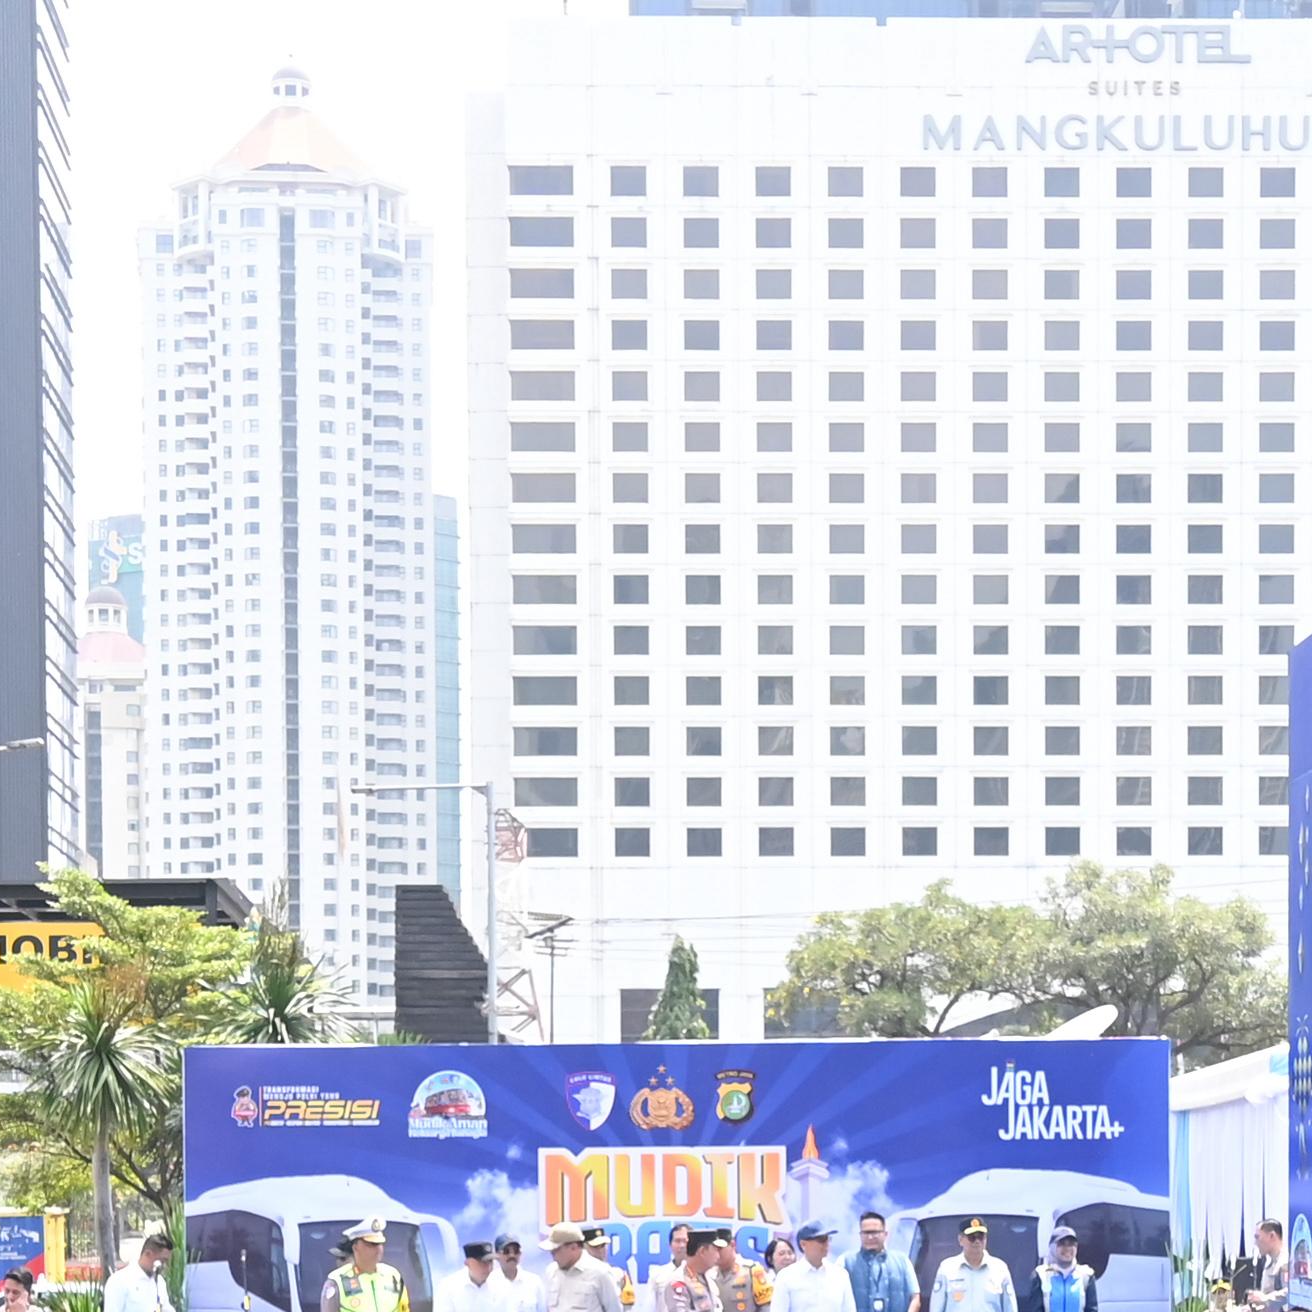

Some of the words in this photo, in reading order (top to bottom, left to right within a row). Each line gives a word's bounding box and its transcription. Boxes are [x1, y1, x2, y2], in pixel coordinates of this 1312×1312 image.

[1088, 80, 1182, 97] SUITES
[980, 1065, 1051, 1106] JAGA
[264, 1099, 381, 1120] PRESISI
[544, 1152, 784, 1226] MUDIK
